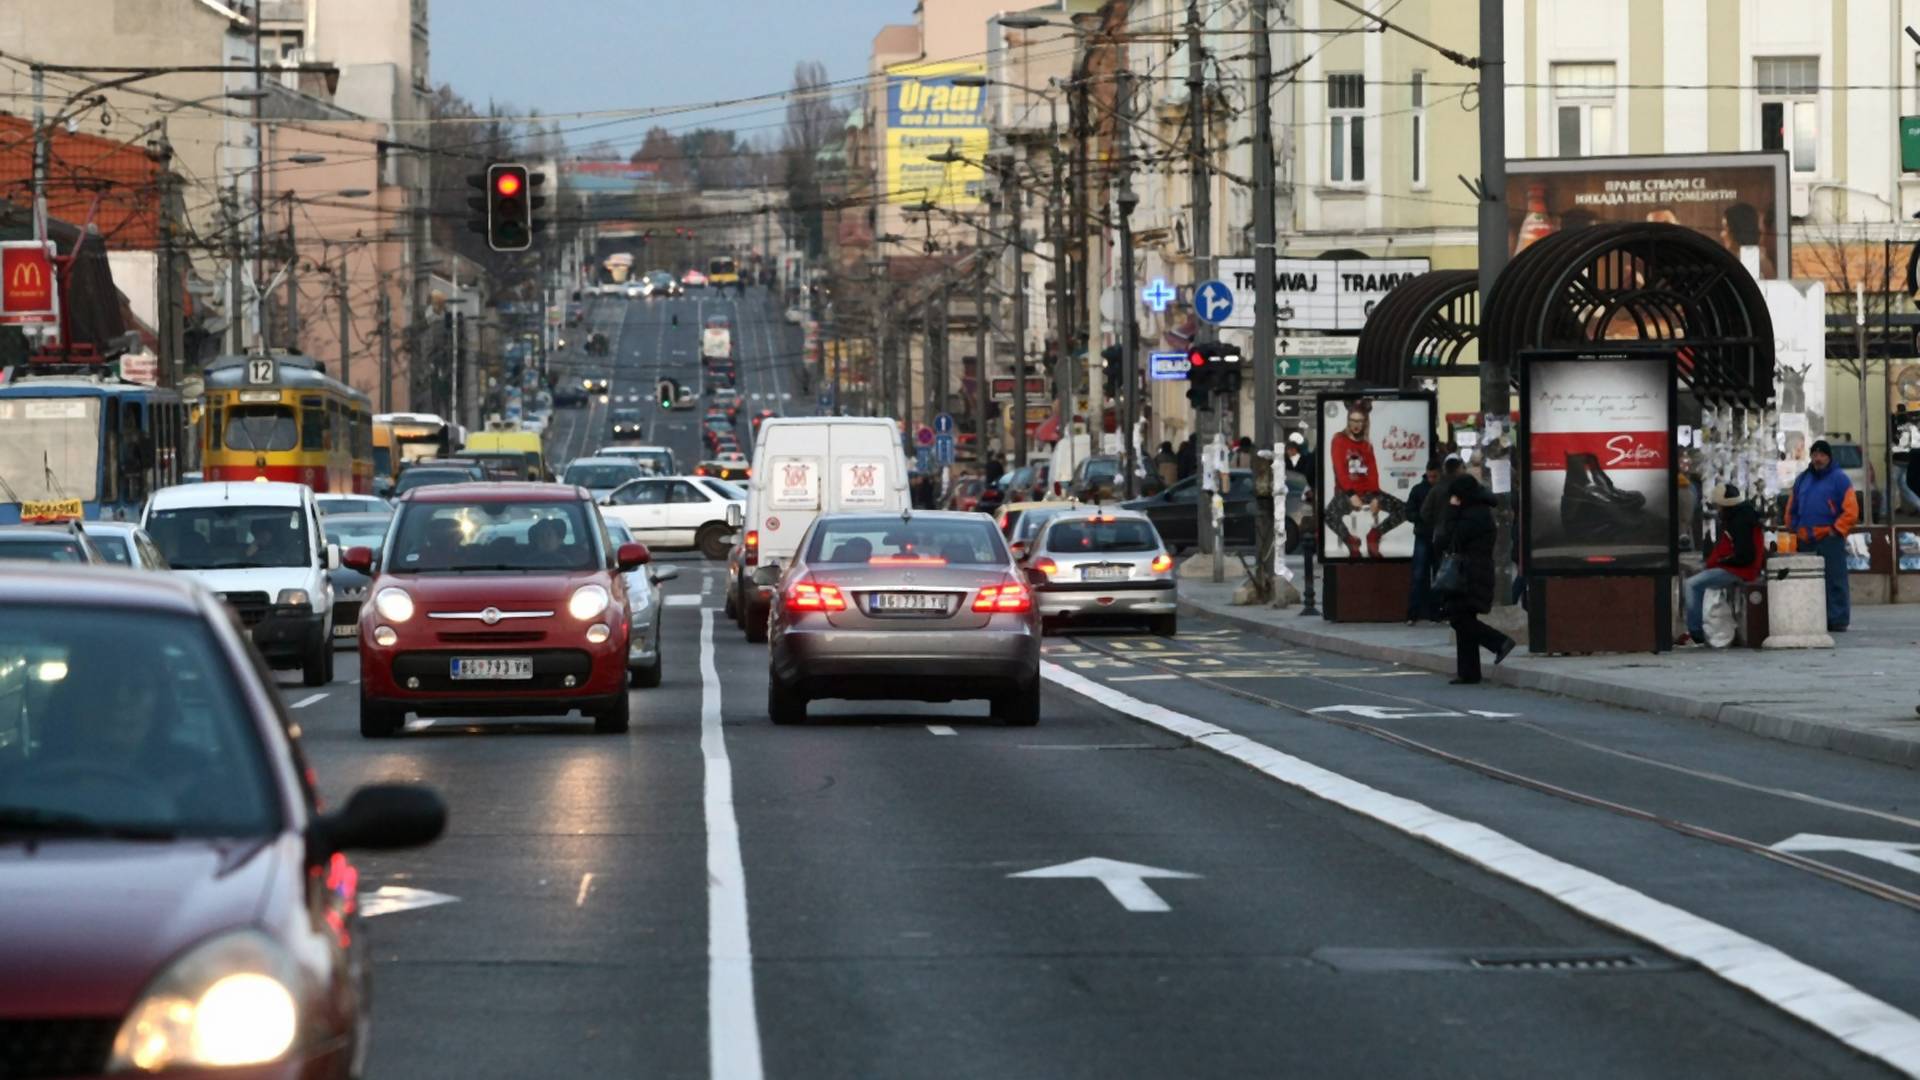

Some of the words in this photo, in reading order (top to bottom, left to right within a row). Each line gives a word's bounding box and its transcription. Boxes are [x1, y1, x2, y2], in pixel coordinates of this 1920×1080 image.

[1645, 178, 1689, 192] СТВАРИ
[1692, 177, 1706, 190] СЕ
[1575, 193, 1624, 206] НИКАДА
[1233, 272, 1318, 292] TRMVAJ
[253, 361, 271, 382] 12
